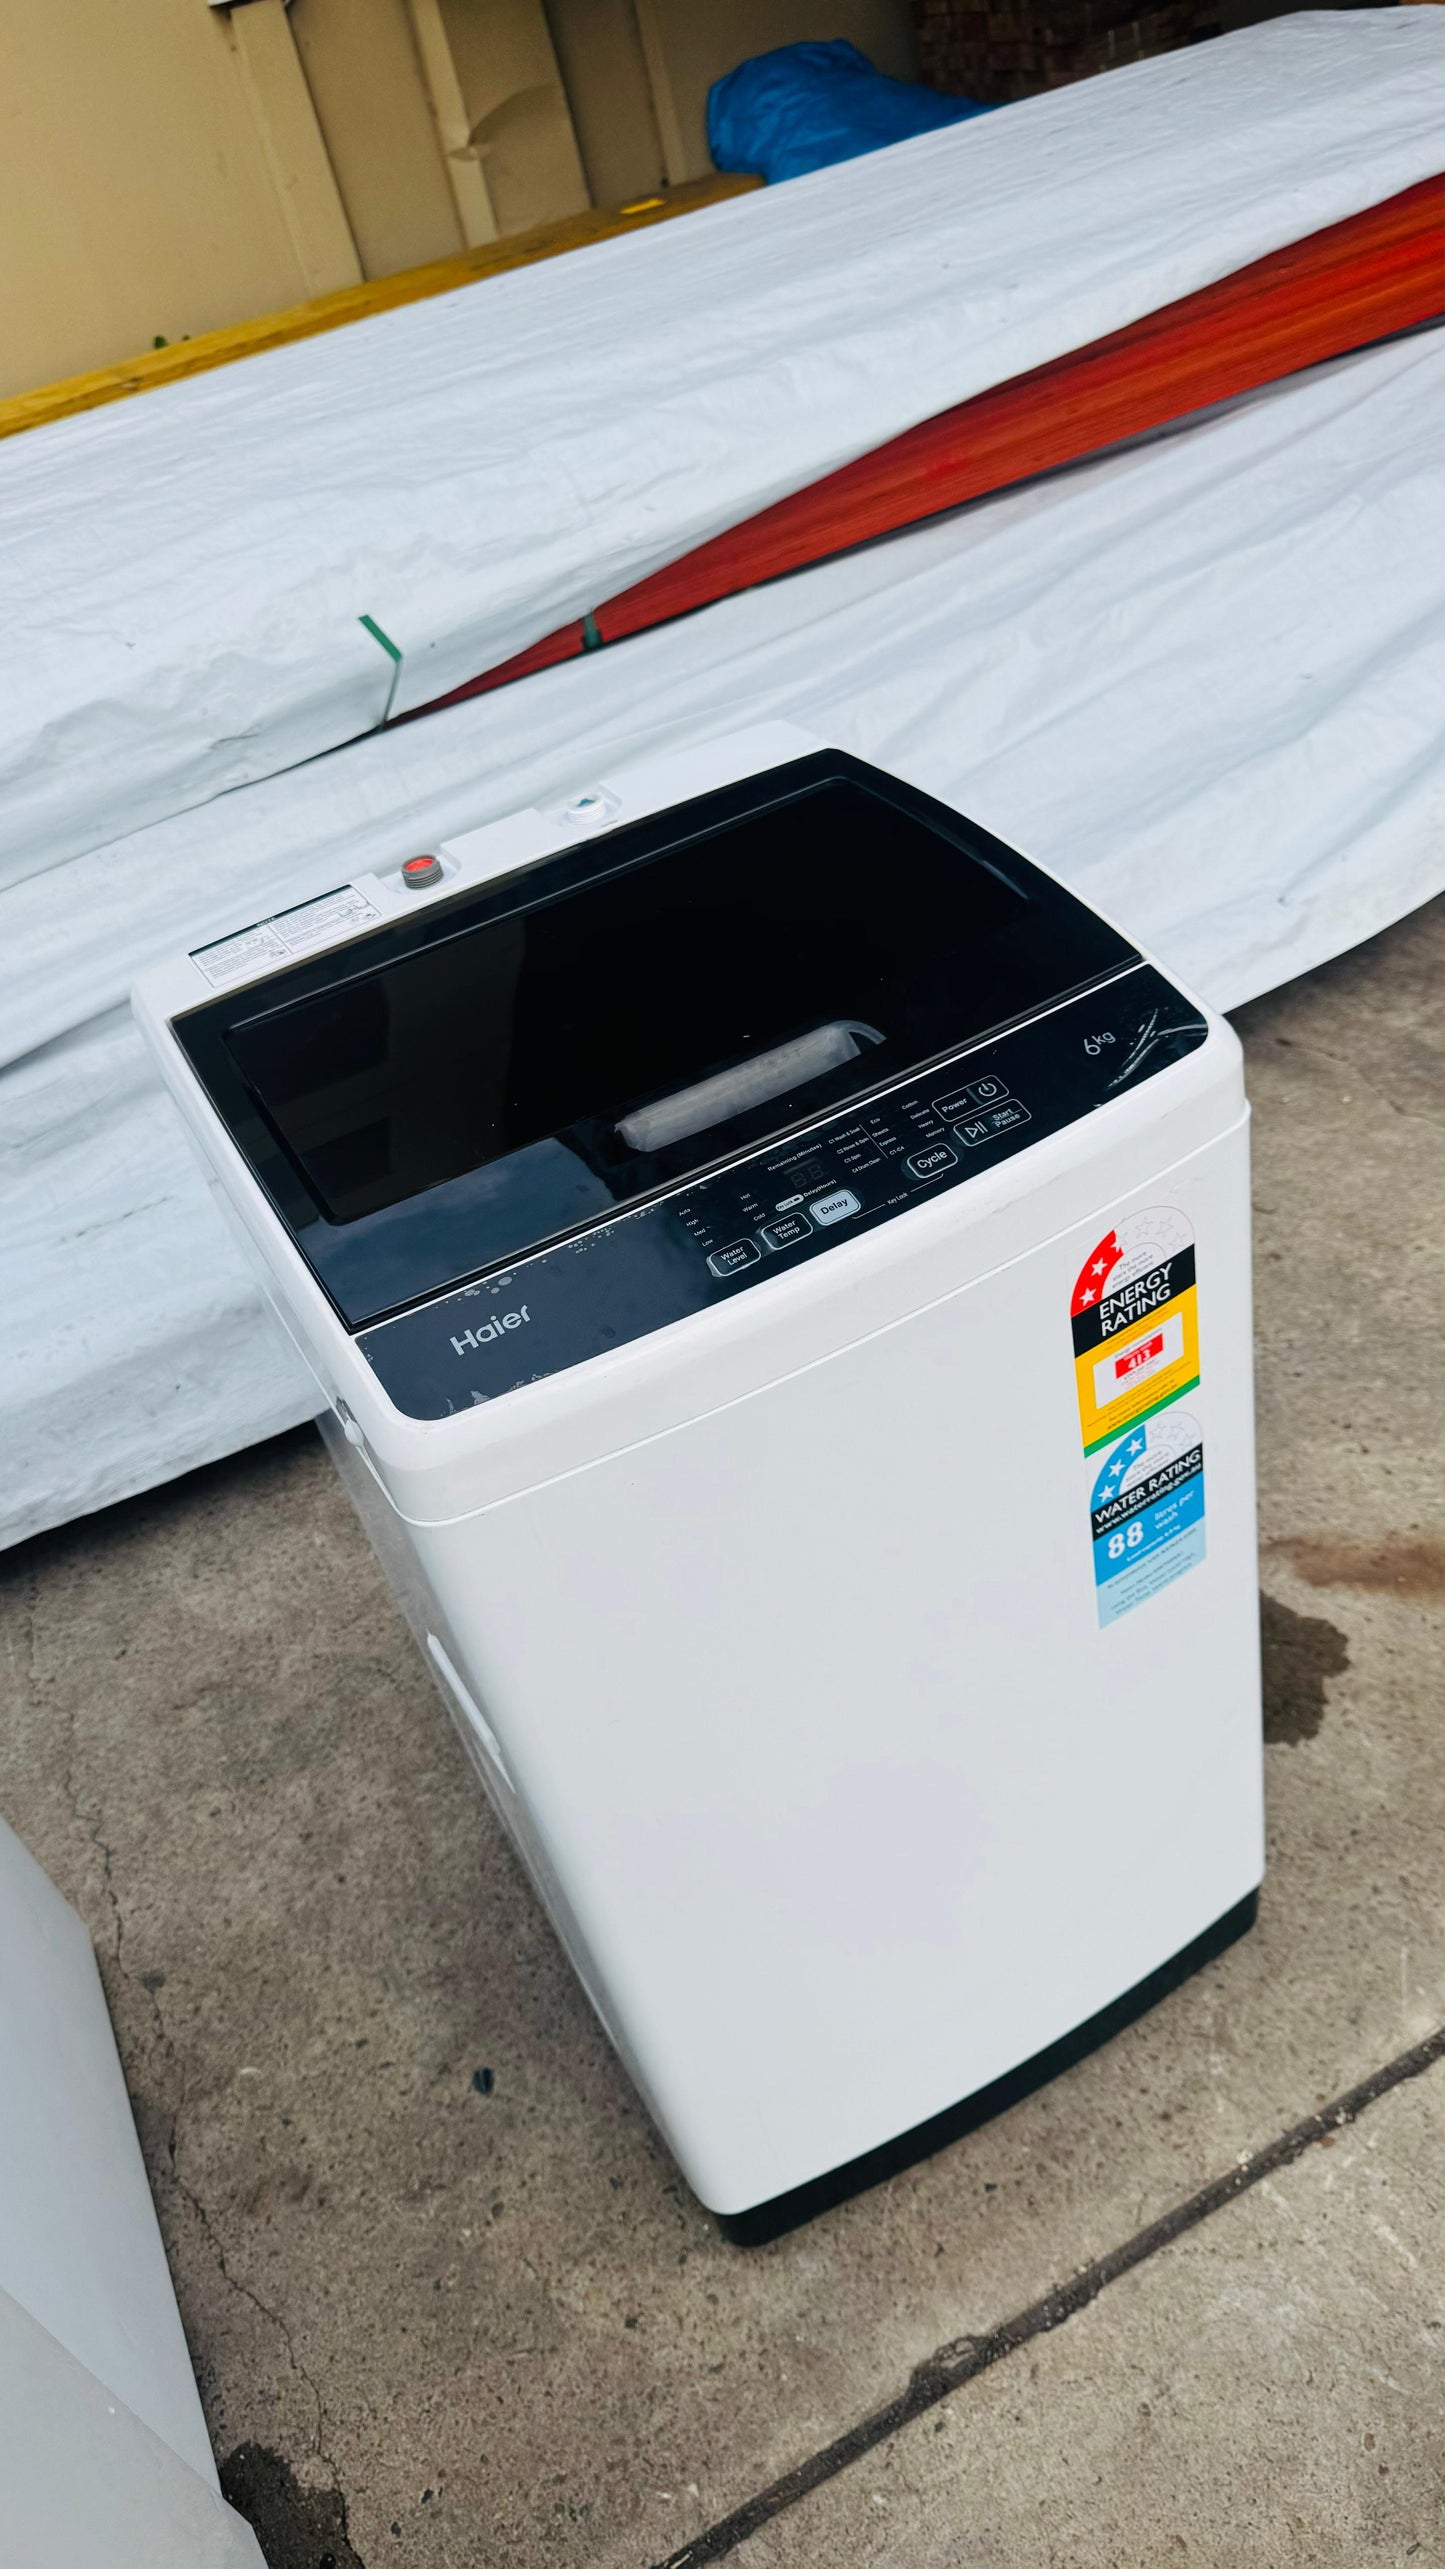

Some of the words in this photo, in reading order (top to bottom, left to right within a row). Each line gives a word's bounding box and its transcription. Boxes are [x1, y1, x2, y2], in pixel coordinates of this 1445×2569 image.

[1083, 1032, 1116, 1055] 6kg
[941, 1098, 968, 1113] Power
[992, 1108, 1014, 1121] Start
[994, 1113, 1021, 1128] Pause
[767, 1155, 797, 1172] Remaining
[917, 1150, 948, 1169] Cycle
[820, 1198, 848, 1214] Delay
[887, 1195, 898, 1205] Key
[897, 1192, 908, 1201] Lock
[742, 1202, 758, 1213] Warm
[753, 1212, 766, 1221] Cold
[772, 1220, 796, 1234] Water
[777, 1226, 801, 1240] Temp
[702, 1238, 714, 1247] Low
[720, 1246, 744, 1260] Water
[727, 1252, 748, 1266] Level
[1100, 1262, 1173, 1320] ENERGY
[1101, 1283, 1171, 1336] RATING
[449, 1304, 531, 1356] Haier
[1128, 1349, 1151, 1369] 413
[1095, 1487, 1146, 1523] WATER
[1149, 1449, 1201, 1492] RATING
[1108, 1521, 1144, 1559] 88
